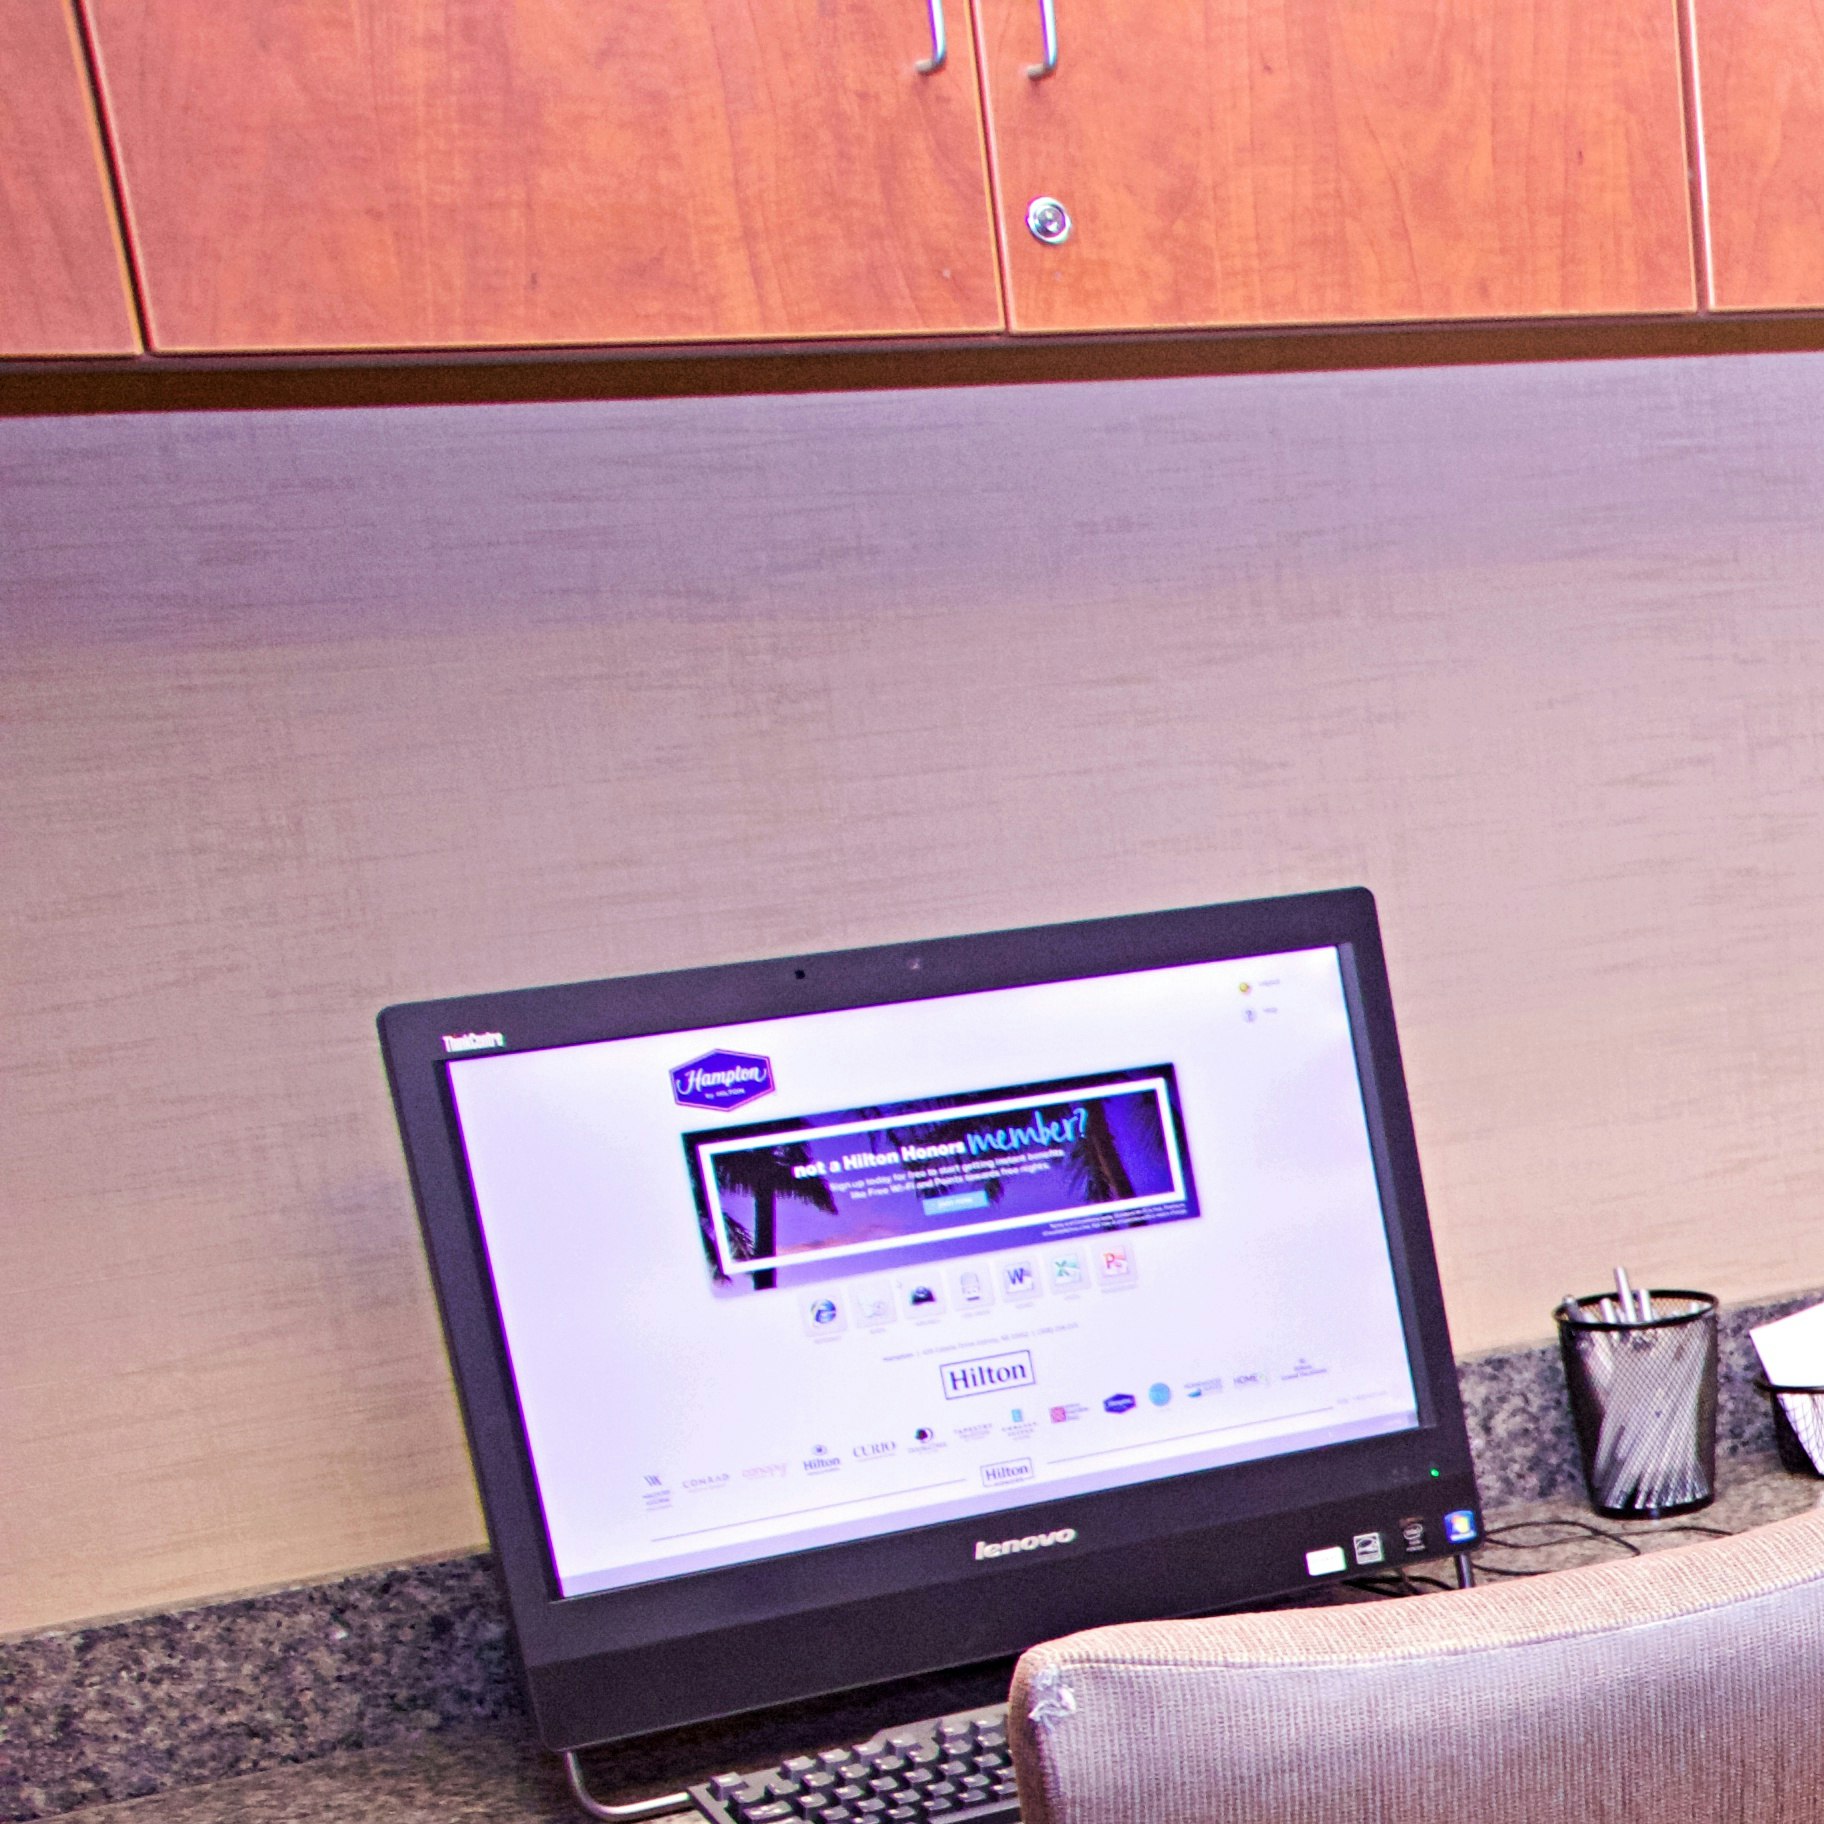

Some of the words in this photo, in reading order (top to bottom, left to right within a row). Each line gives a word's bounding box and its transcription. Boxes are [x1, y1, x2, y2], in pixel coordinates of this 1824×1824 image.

[676, 1065, 767, 1095] Hampton
[791, 1161, 827, 1179] not
[829, 1160, 841, 1173] a
[842, 1150, 899, 1171] Hilton
[901, 1141, 967, 1162] Honors
[966, 1107, 1089, 1156] member?
[948, 1362, 1027, 1392] Hilton
[803, 1457, 841, 1472] Hilton
[853, 1441, 897, 1458] CURIO
[985, 1463, 1029, 1481] Hilton
[975, 1528, 1077, 1561] lenovo
